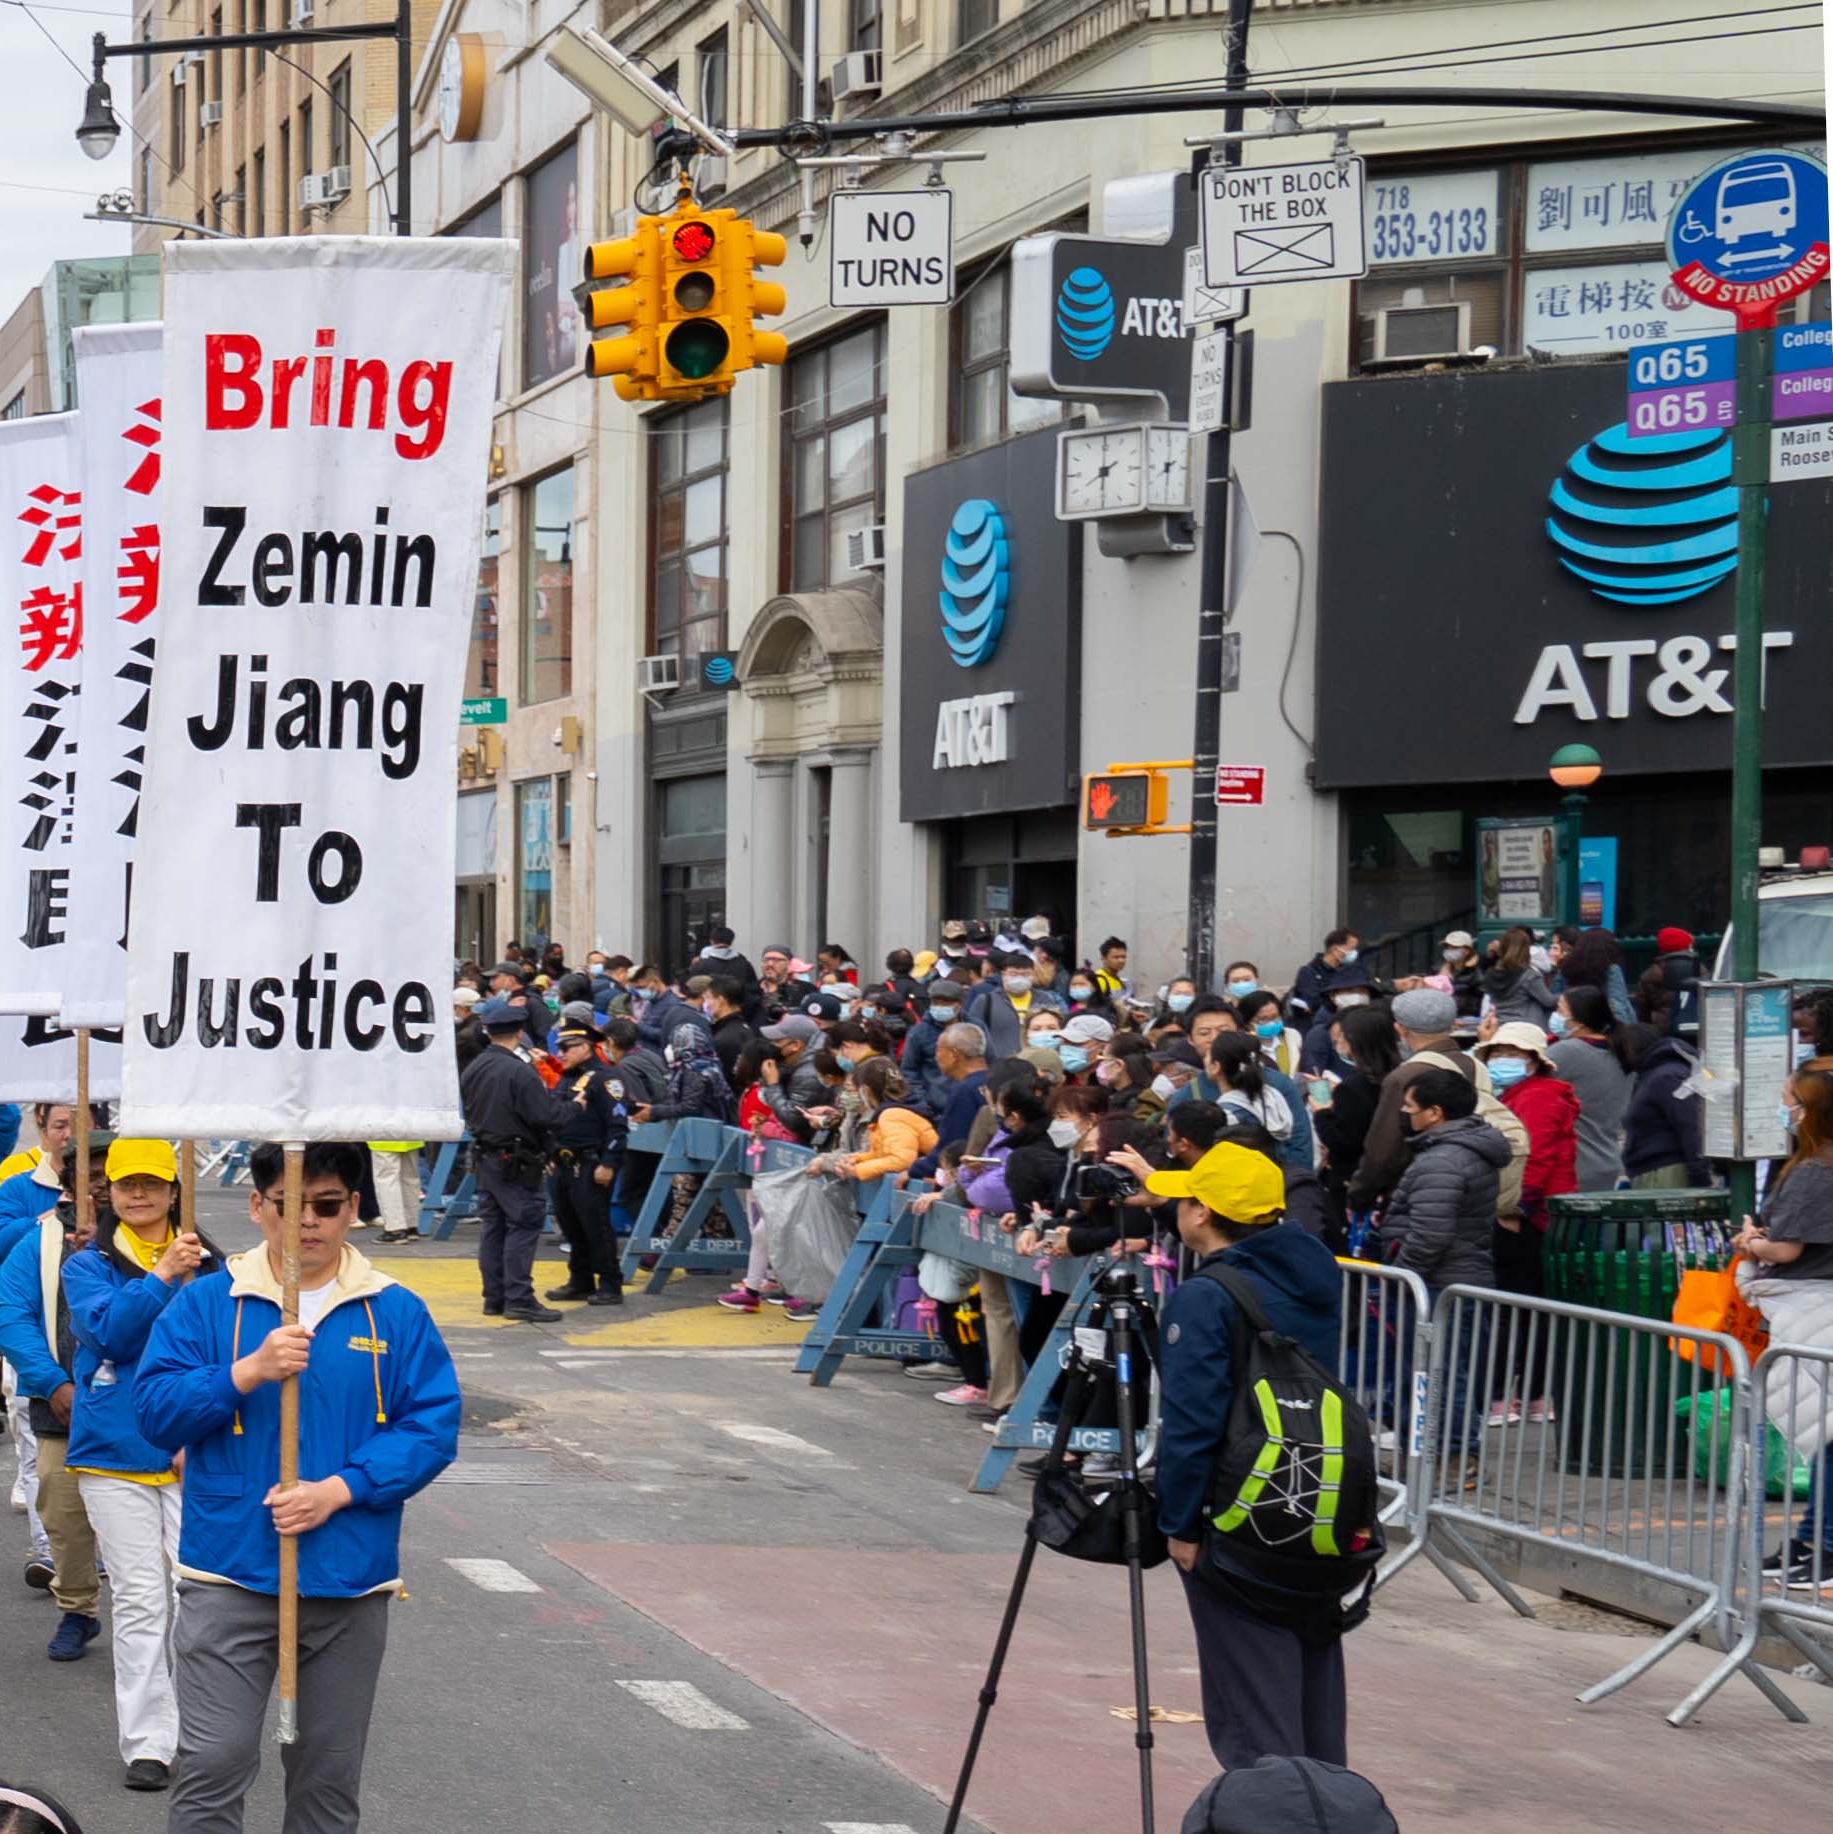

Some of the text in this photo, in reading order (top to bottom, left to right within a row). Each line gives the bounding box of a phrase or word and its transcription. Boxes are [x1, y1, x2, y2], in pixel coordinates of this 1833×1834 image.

[1213, 169, 1351, 200] DON'T BLOCK
[1376, 186, 1410, 210] 718
[1238, 197, 1327, 223] THE BOX
[1537, 176, 1686, 233] 劉可風
[867, 211, 916, 243] NO
[1373, 207, 1487, 259] 353-3133
[838, 257, 943, 288] TURNS
[1684, 250, 1829, 304] NO STANDING
[1782, 331, 1833, 349] Colleg
[1636, 344, 1708, 385] Q65
[206, 329, 452, 459] Bring
[1781, 377, 1833, 395] Colleg
[1636, 391, 1732, 430] Q65 LTD
[1781, 430, 1821, 446] Main
[1780, 451, 1833, 467] Roose
[199, 507, 435, 607] Zemin
[188, 655, 423, 779] Jiang
[933, 691, 1015, 770] AT&T
[237, 804, 362, 904] To
[144, 952, 433, 1052] Justice
[854, 1341, 921, 1358] POLICE
